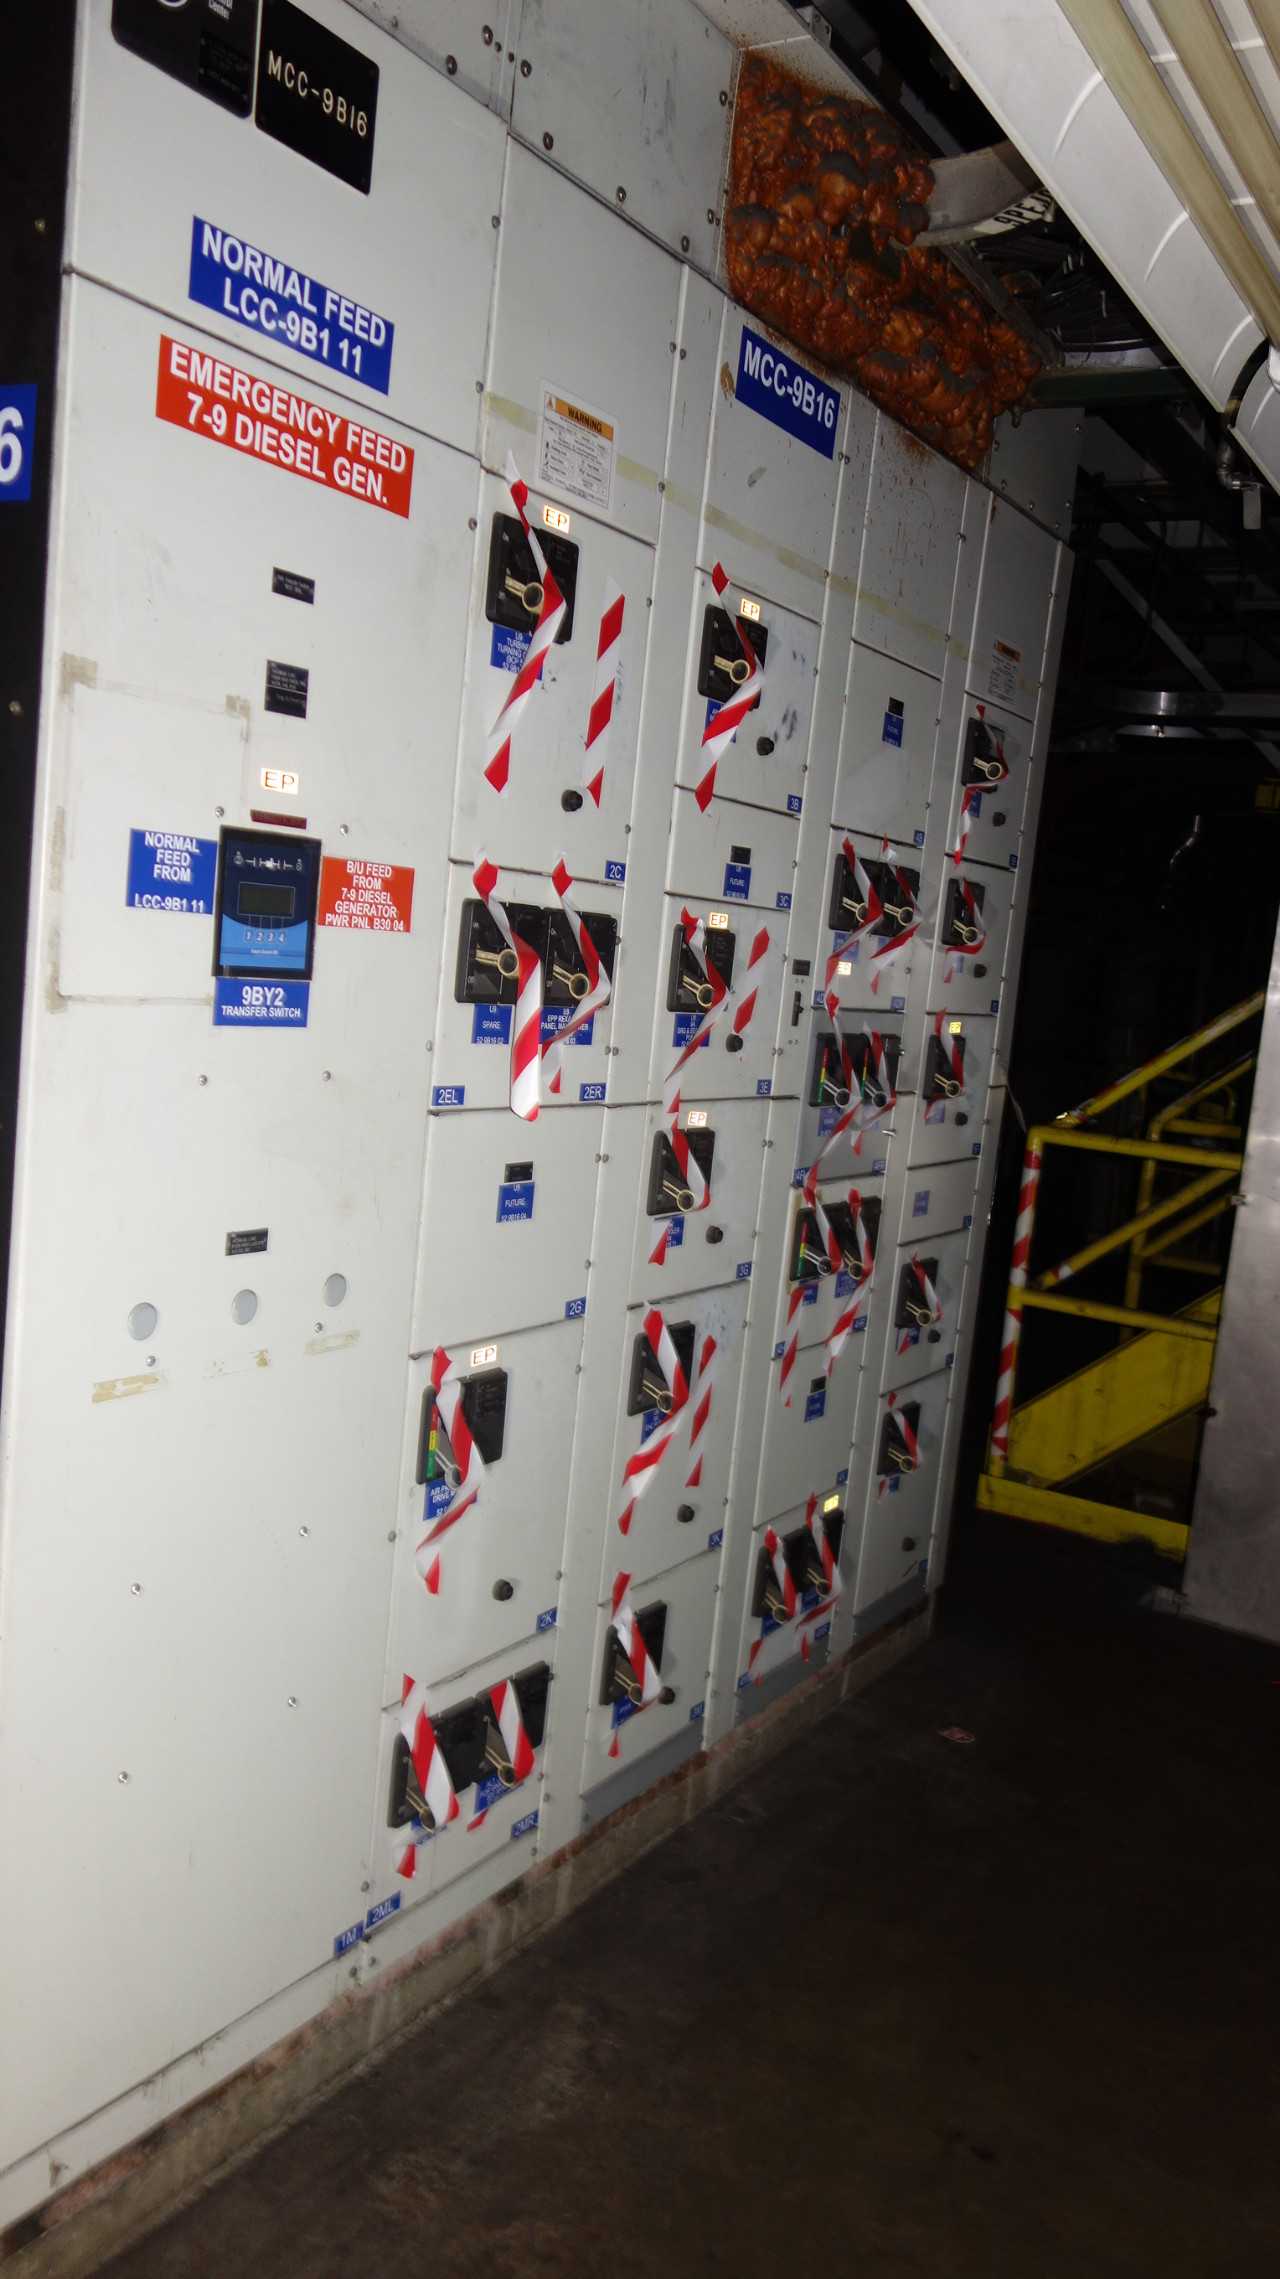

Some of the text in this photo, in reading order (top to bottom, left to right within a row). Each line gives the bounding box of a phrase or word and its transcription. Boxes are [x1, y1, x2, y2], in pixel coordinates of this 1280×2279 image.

[268, 50, 368, 137] MCC-9B16
[202, 223, 386, 347] NORMAL FEED
[223, 277, 362, 376] LCC-9B1 11
[743, 339, 835, 429] MCC-9B16
[170, 342, 406, 474] EMERGENCY FEED
[567, 406, 602, 433] WARNING
[186, 392, 389, 504] 7-9 DIESEL GEN.
[546, 508, 568, 528] EP
[742, 601, 758, 617] EP
[265, 771, 295, 790] EP
[144, 831, 200, 853] NORMAL
[156, 848, 191, 867] FEED
[153, 864, 192, 882] FROM
[346, 860, 392, 878] B/U FEED
[609, 864, 622, 880] 2C
[352, 875, 382, 889] FROM
[134, 893, 204, 913] LCC-9B1 11
[341, 887, 393, 905] 7-9 DIESEL
[334, 900, 398, 918] GENERATOR
[325, 913, 404, 931] PWR PNL B30 04
[711, 914, 727, 927] EP
[242, 985, 284, 1006] 9BY2
[221, 1004, 301, 1018] TRANSFER SWITCH
[438, 1088, 459, 1104] 2EL
[584, 1085, 602, 1100] 2ER
[688, 1111, 706, 1125] EP
[569, 1301, 582, 1316] 2G
[473, 1347, 495, 1365] EP
[540, 1610, 553, 1627] 2K
[372, 1900, 394, 1922] 2ML
[342, 1927, 357, 1949] 1M
